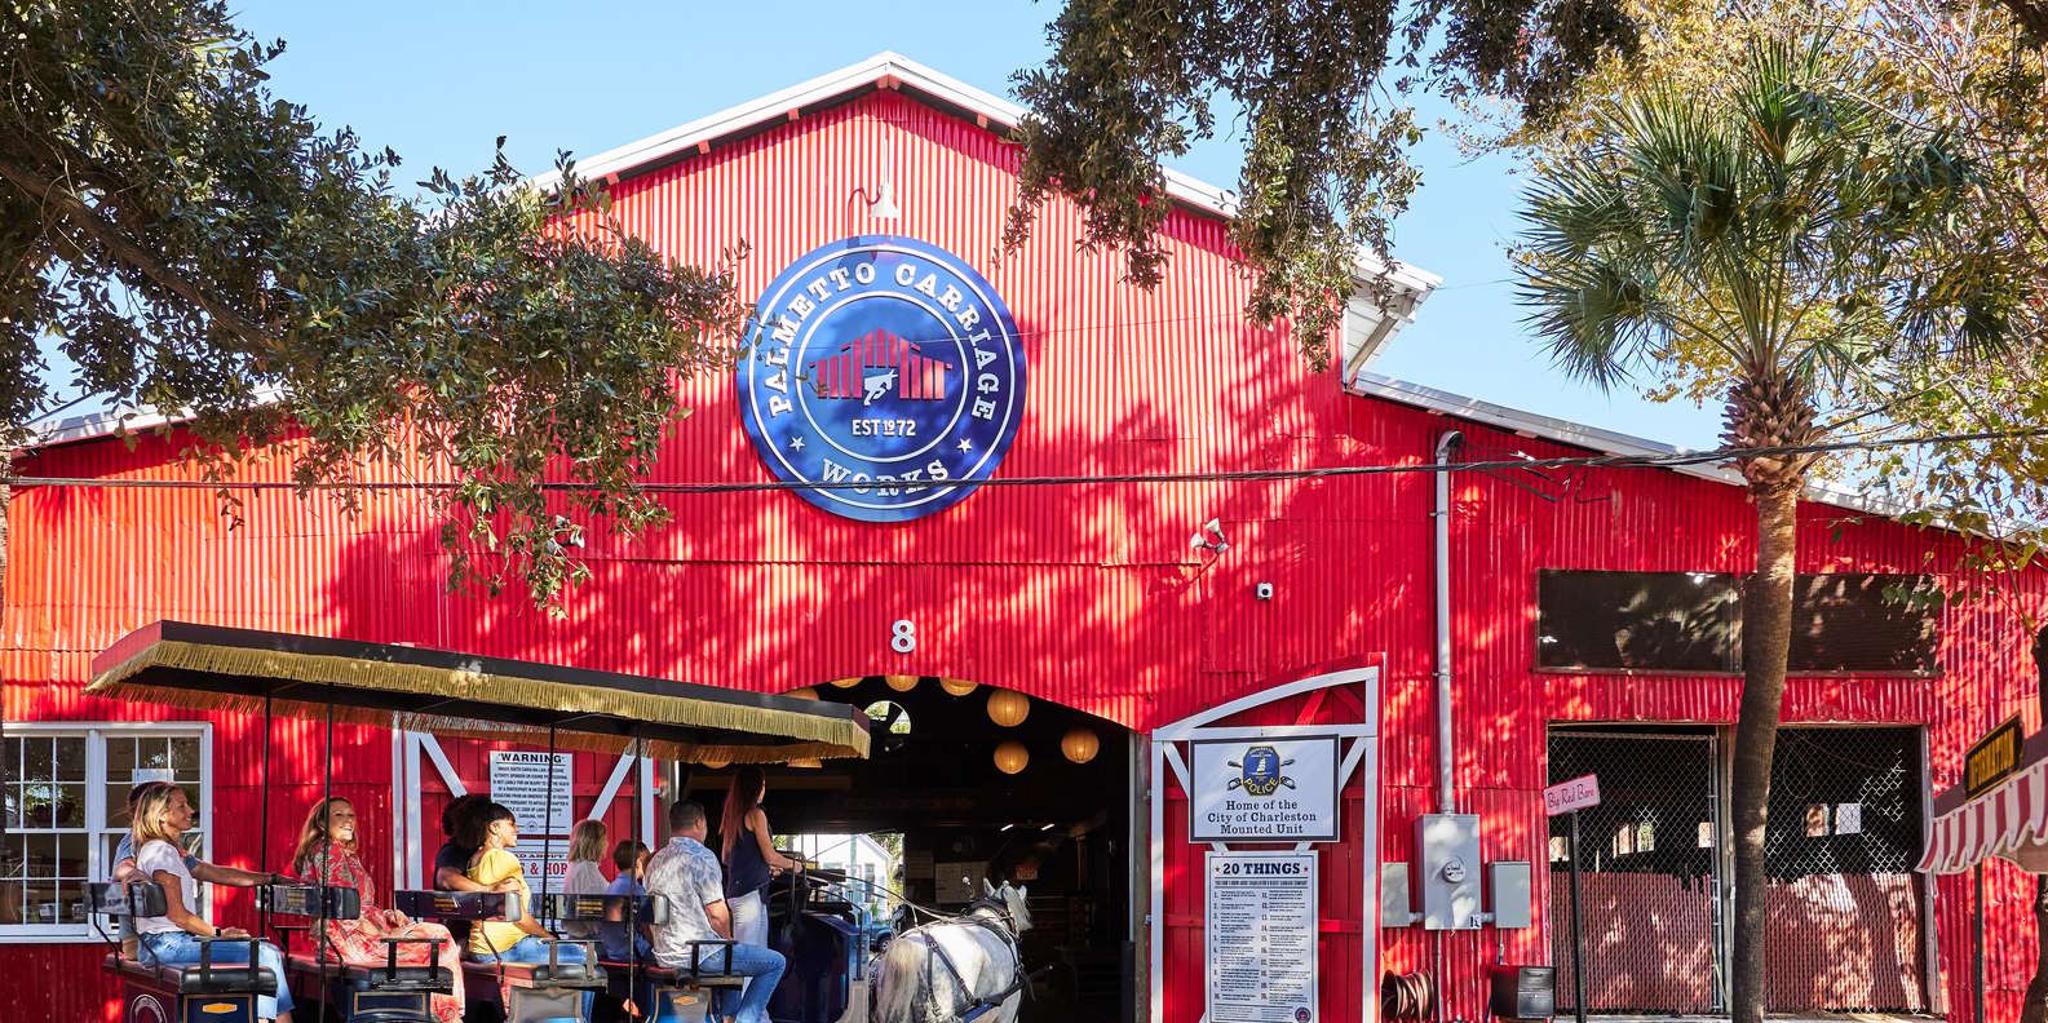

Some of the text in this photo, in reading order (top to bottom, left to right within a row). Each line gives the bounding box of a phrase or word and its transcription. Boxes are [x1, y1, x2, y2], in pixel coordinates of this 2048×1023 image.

[765, 262, 1000, 421] PALMETTO CARRIAGE
[852, 419, 917, 437] EST 1972
[821, 458, 950, 497] WORKS
[891, 619, 916, 653] 8
[1243, 776, 1279, 795] POLICE
[1226, 799, 1298, 811] Home of the
[1561, 787, 1576, 805] Red
[1208, 811, 1317, 825] City of Charleston
[1220, 823, 1304, 835] Mounted Unit
[1223, 862, 1301, 875] 20 THINGS
